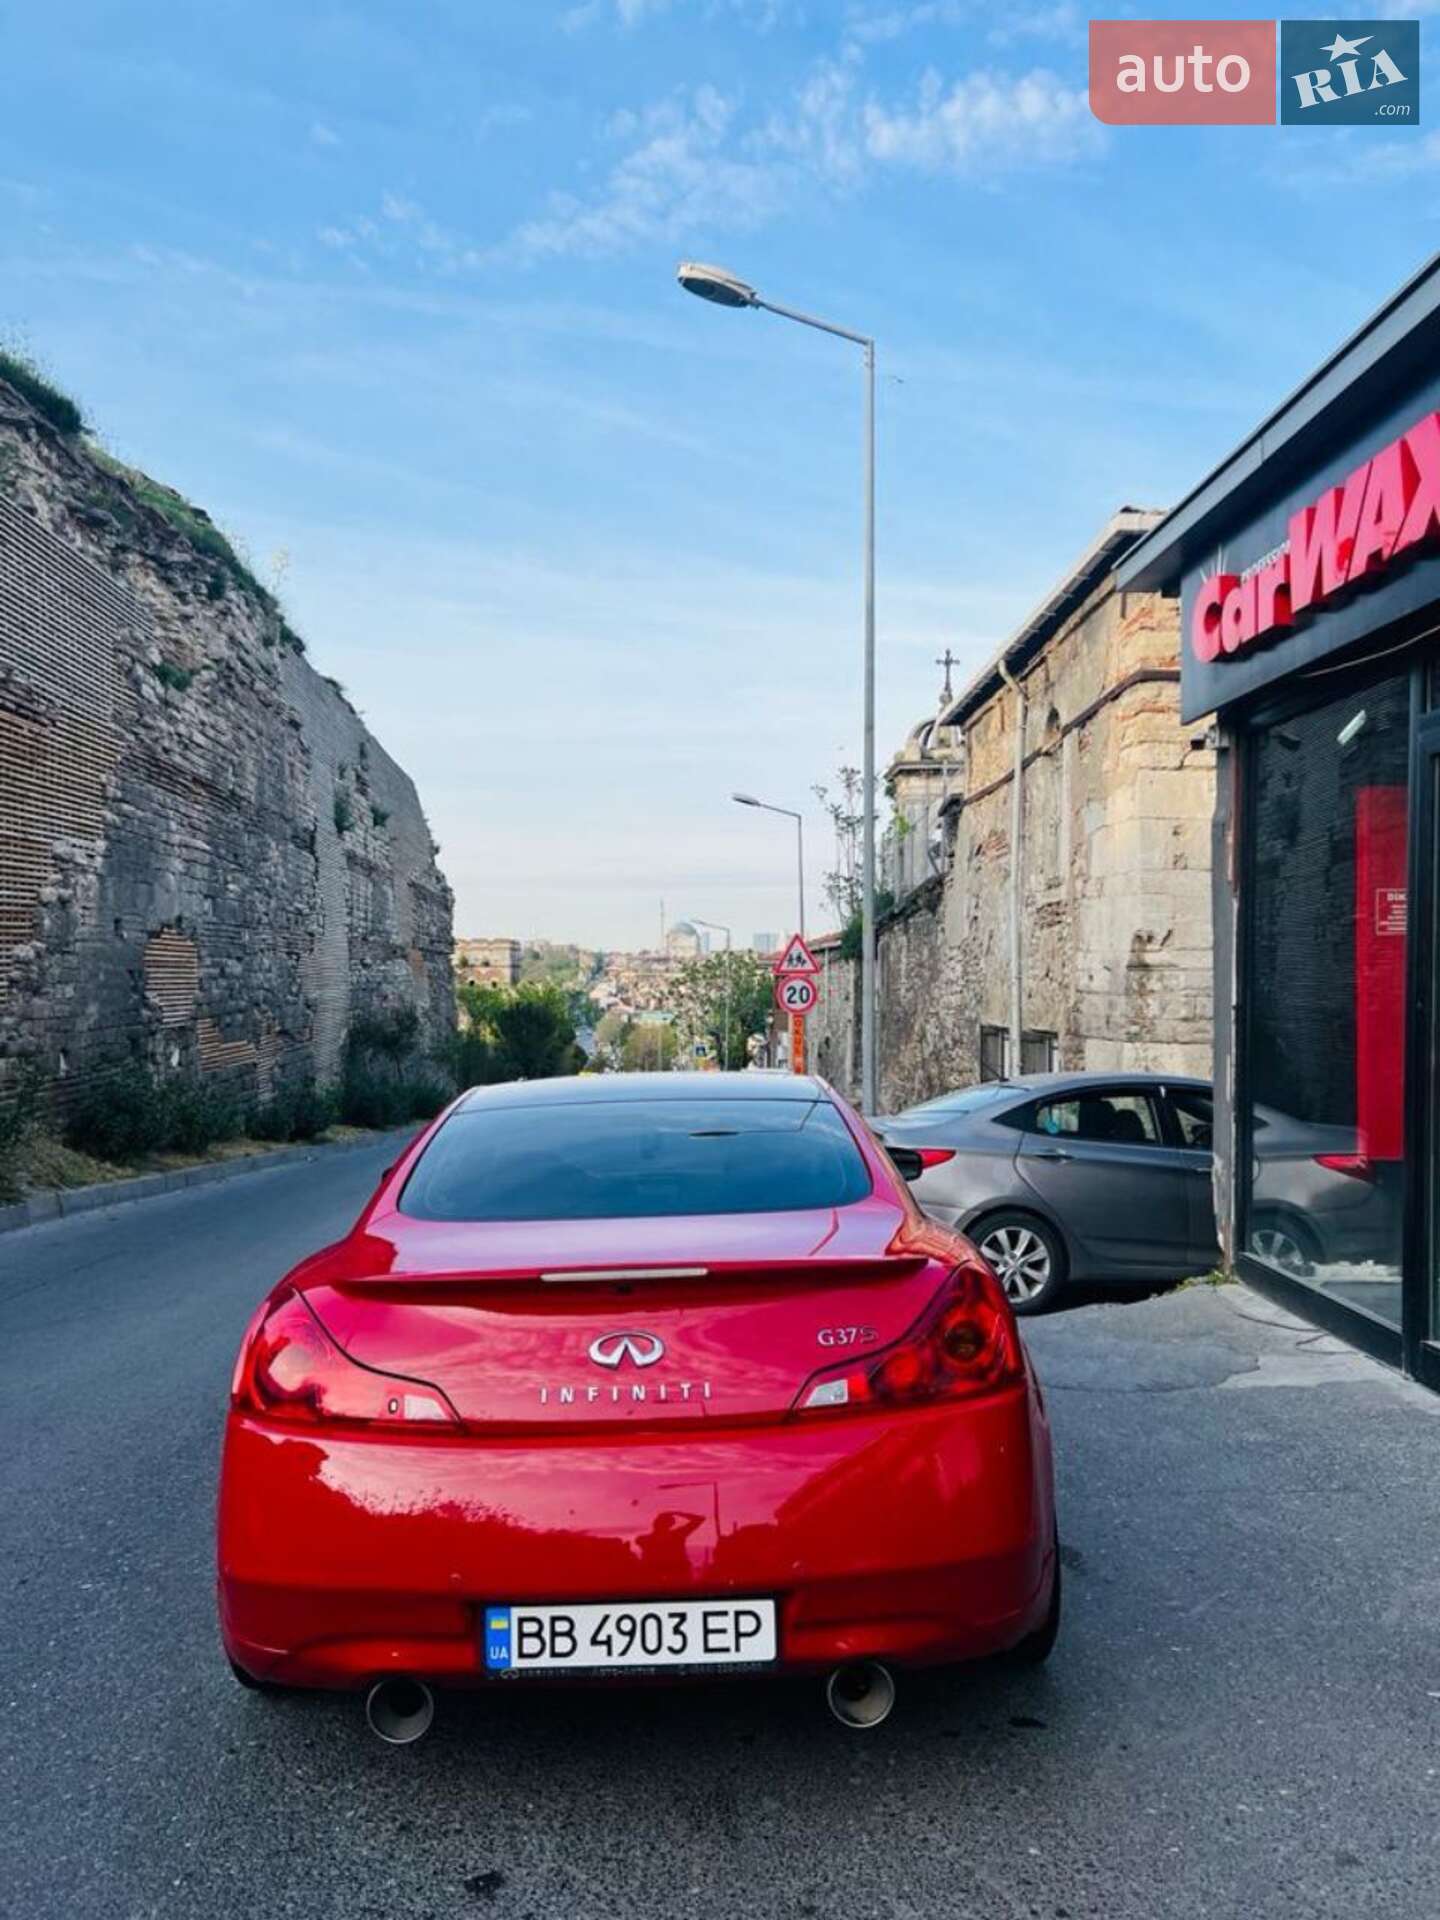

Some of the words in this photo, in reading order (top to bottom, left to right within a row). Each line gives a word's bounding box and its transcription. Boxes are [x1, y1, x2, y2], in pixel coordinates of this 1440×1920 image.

[786, 985, 811, 1004] 20
[817, 1326, 879, 1346] G37S
[540, 1382, 711, 1403] INFINITI
[517, 1616, 578, 1659] BB
[590, 1612, 688, 1656] 4903
[703, 1610, 762, 1653] EP
[490, 1647, 508, 1660] UA
